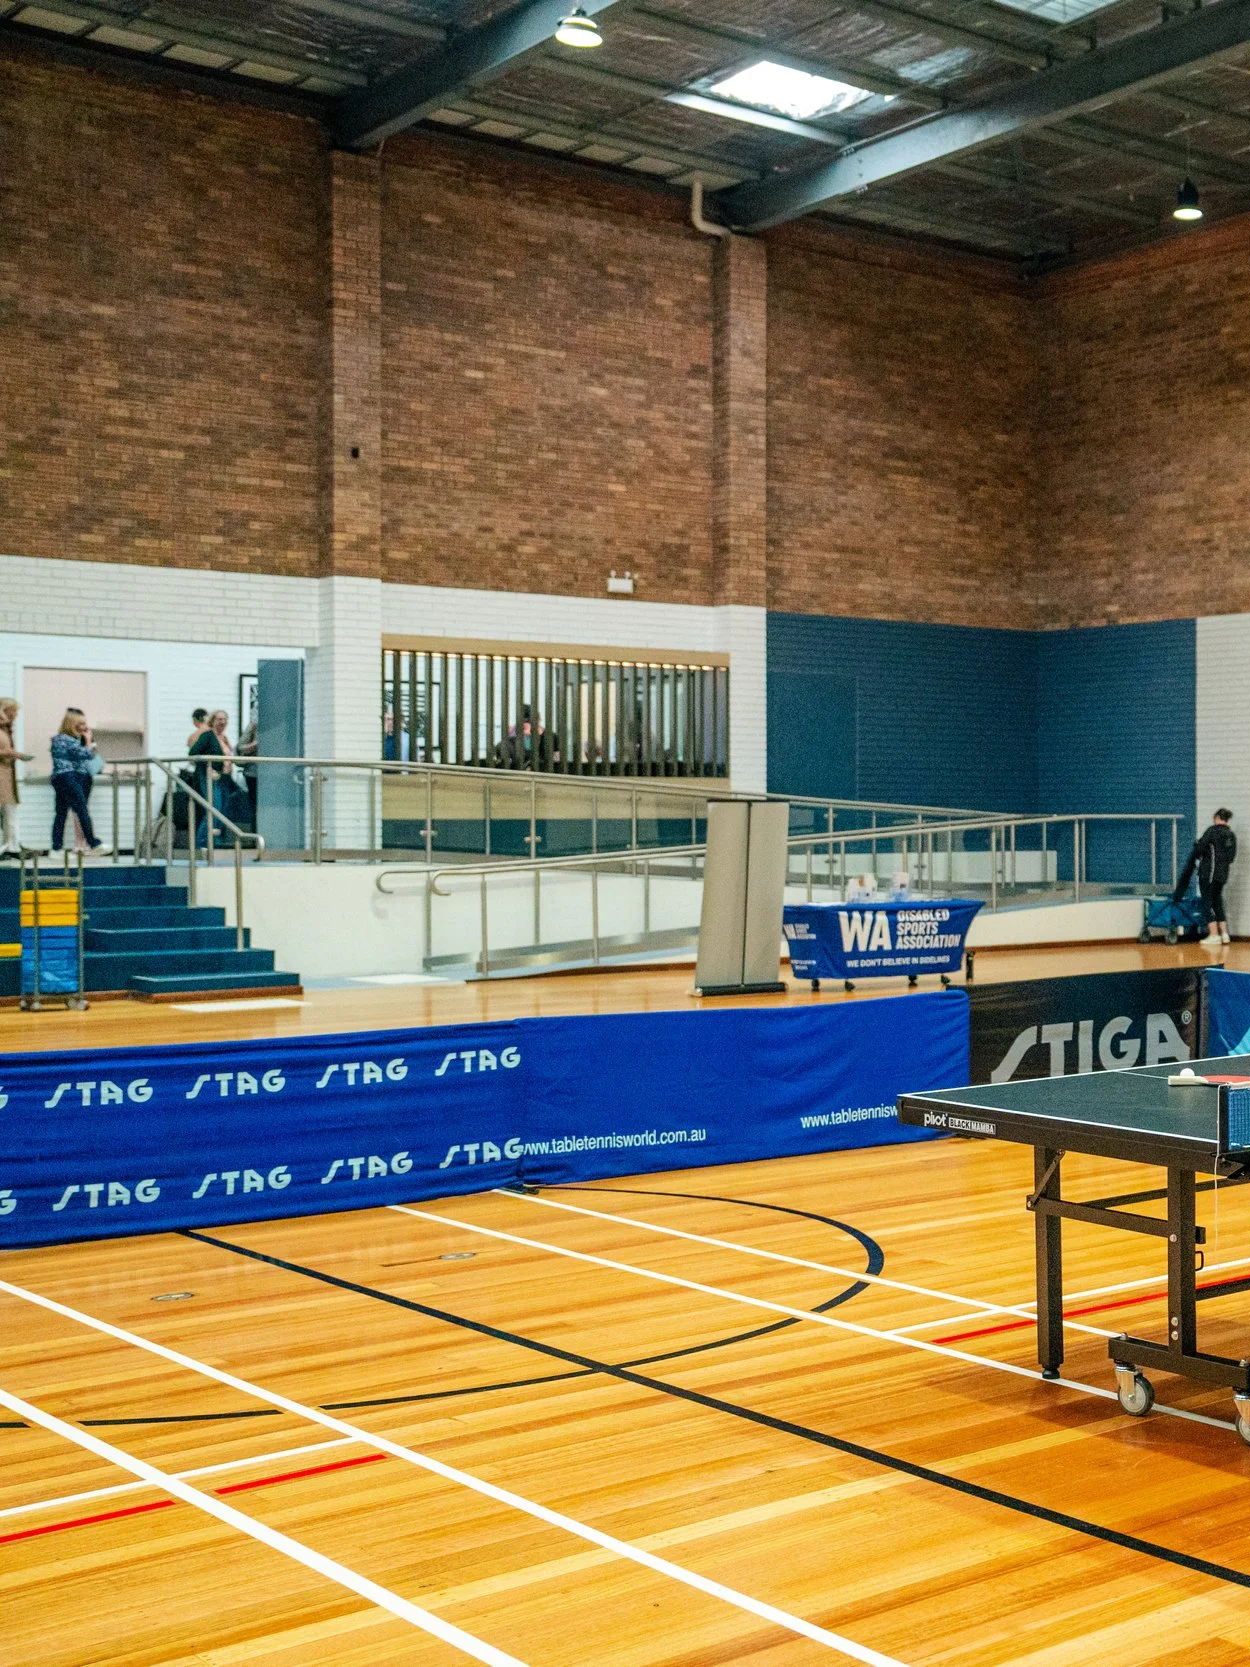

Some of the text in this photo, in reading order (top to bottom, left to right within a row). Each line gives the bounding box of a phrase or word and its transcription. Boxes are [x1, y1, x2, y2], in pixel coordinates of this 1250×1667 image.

[896, 908, 950, 922] DISABLED
[838, 910, 892, 952] WA
[896, 922, 939, 936] SPORTS
[895, 934, 961, 950] ASSOCIATION
[846, 960, 859, 968] WE
[882, 957, 911, 967] BELIEVE
[911, 956, 919, 965] IN
[44, 1079, 154, 1109] STAG
[186, 1069, 286, 1099] STAG
[315, 1058, 409, 1089] STAG
[434, 1046, 522, 1077] STAG
[52, 1178, 161, 1212] STAG
[192, 1166, 292, 1199] STAG
[320, 1151, 414, 1184] STAG
[438, 1137, 524, 1169] STAG
